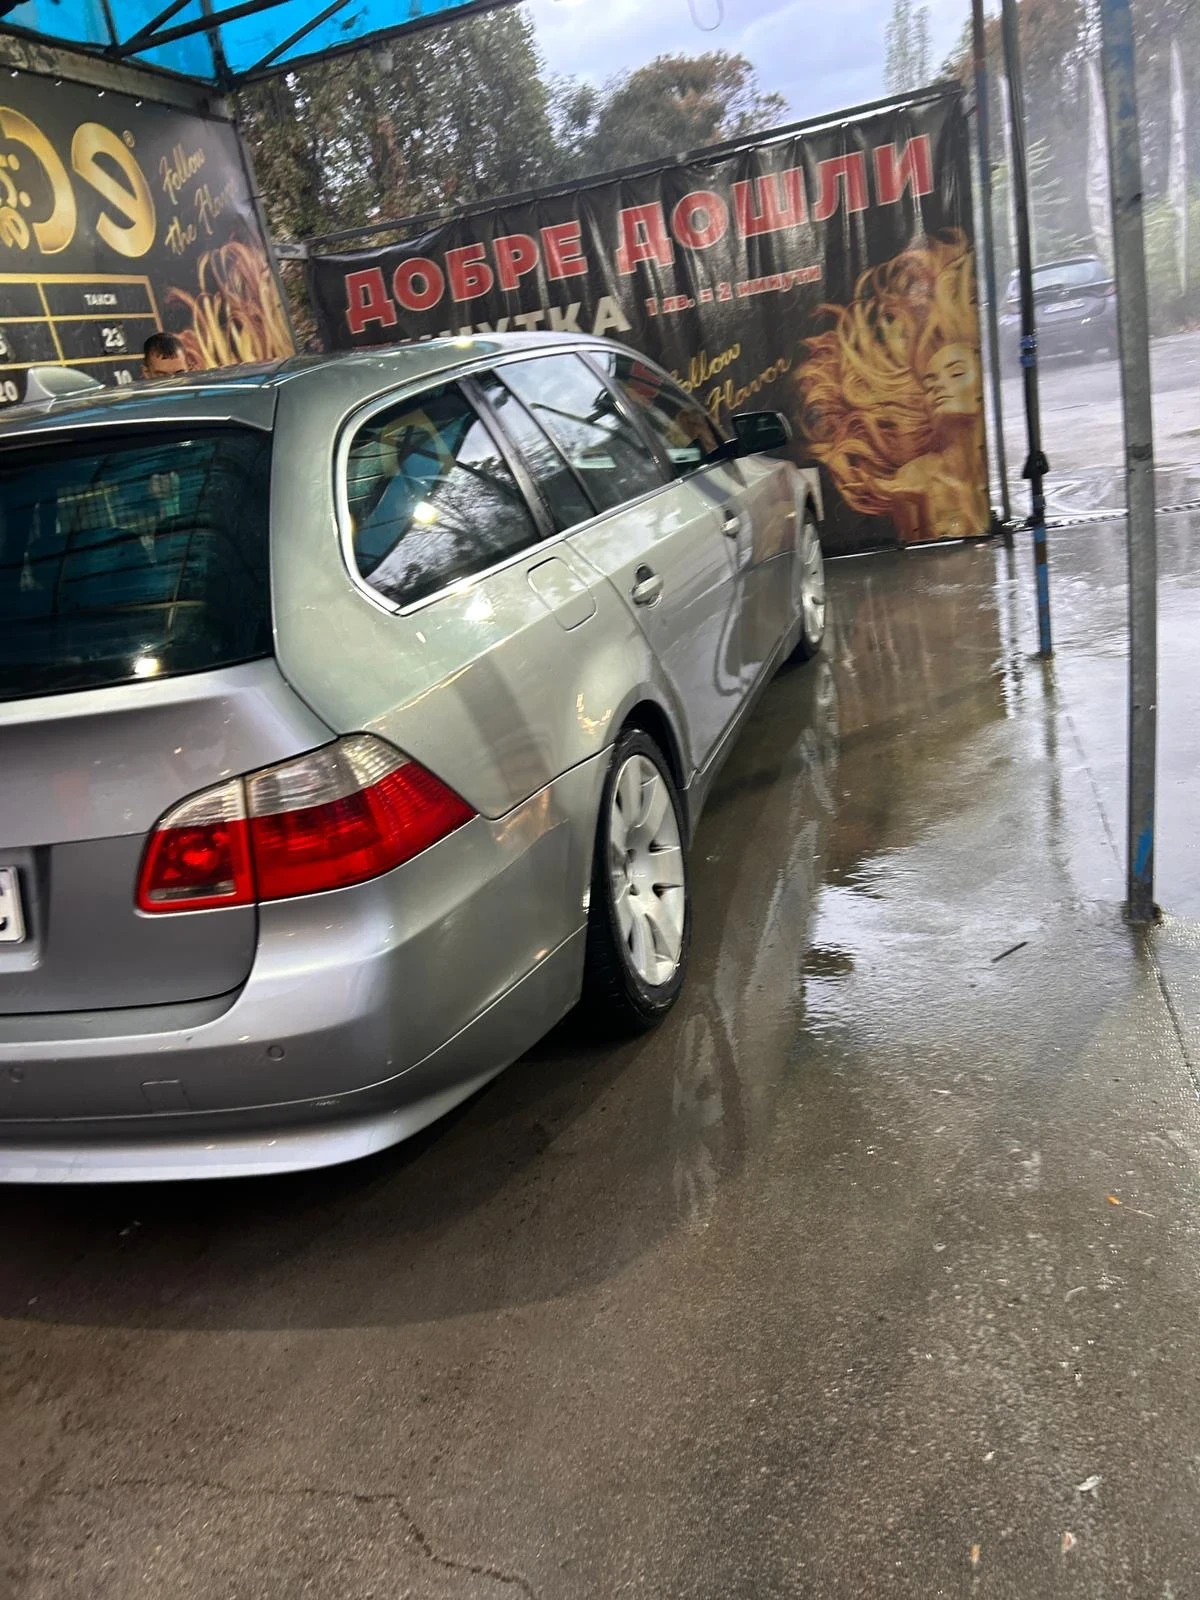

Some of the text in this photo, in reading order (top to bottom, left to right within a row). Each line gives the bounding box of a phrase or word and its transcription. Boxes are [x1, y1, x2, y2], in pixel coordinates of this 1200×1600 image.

[159, 143, 206, 205] Follow
[344, 133, 935, 334] ДОБРЕ ДОШЛИ
[645, 296, 659, 317] 1
[716, 281, 734, 302] 2
